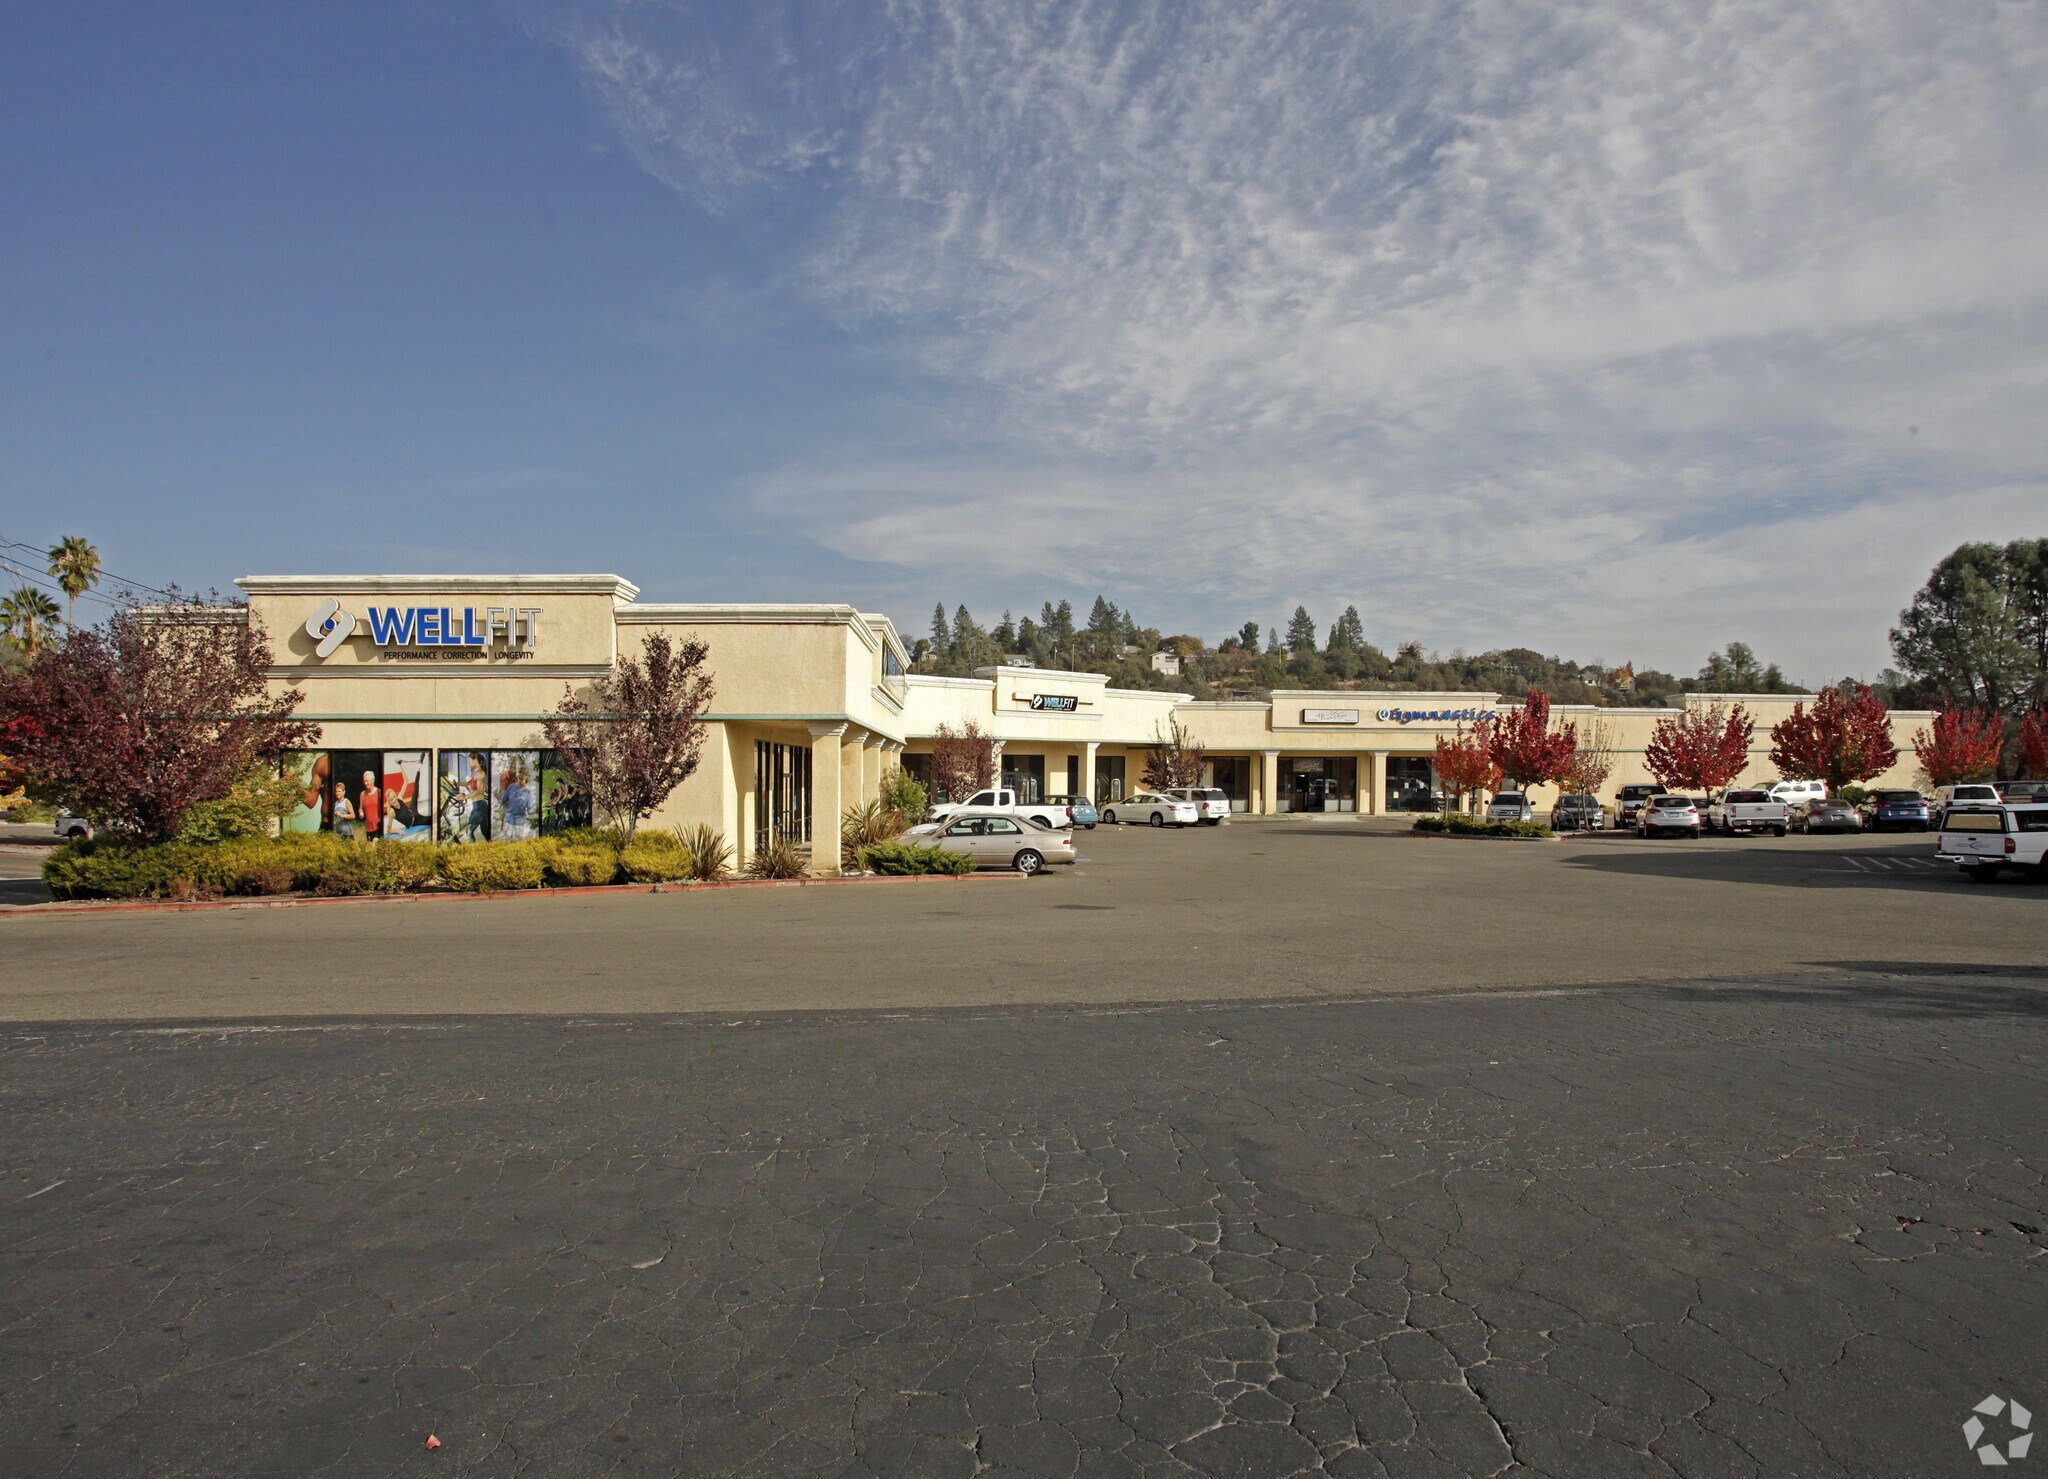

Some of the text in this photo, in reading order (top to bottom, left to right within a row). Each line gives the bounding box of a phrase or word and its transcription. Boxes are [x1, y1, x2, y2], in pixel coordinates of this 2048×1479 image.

[367, 606, 543, 647] WELLFIT
[384, 651, 535, 660] PERFORMANCE CORRECTION LONGEVITY
[1043, 697, 1075, 708] WELLFIT
[1391, 707, 1496, 723] Gymnastics
